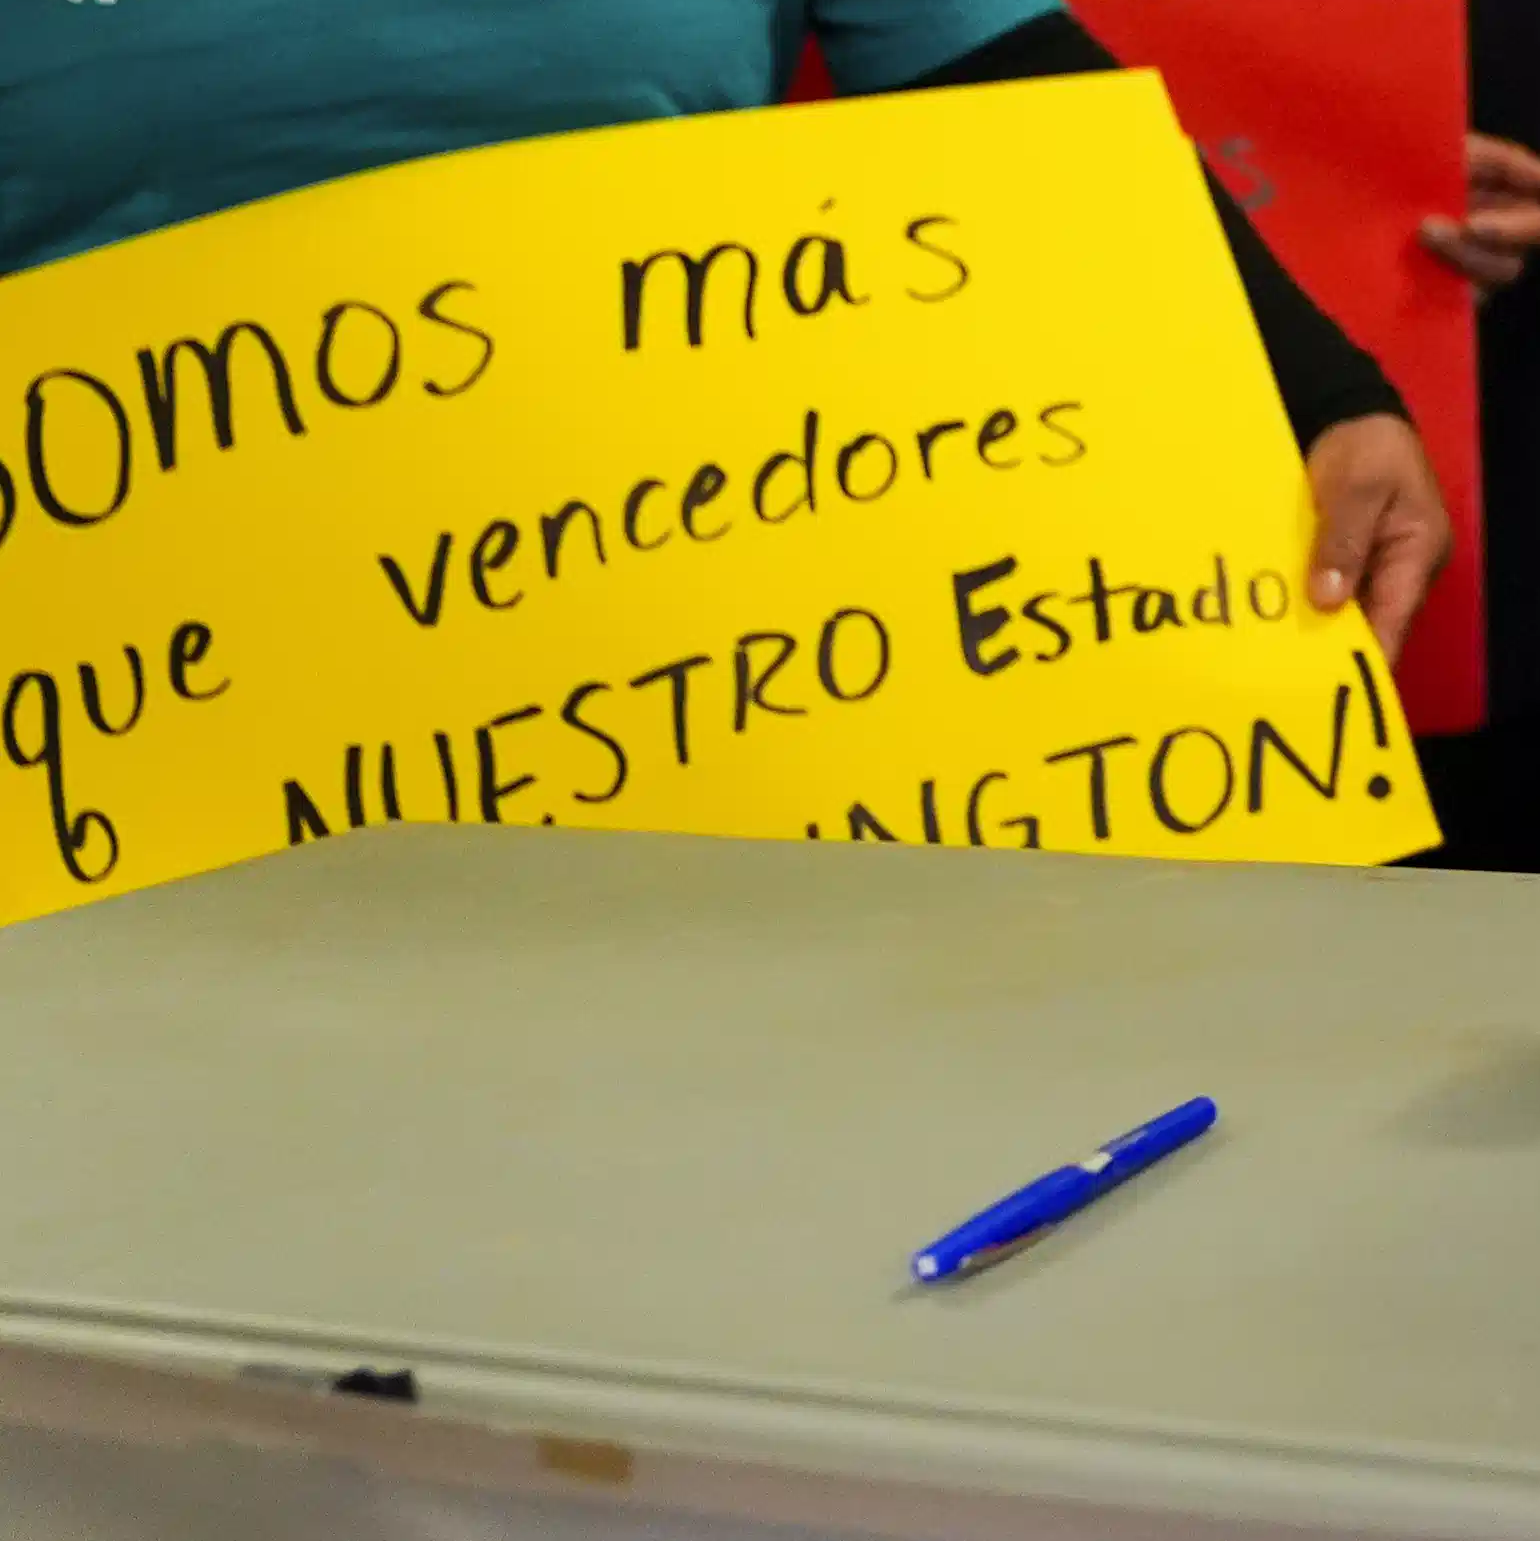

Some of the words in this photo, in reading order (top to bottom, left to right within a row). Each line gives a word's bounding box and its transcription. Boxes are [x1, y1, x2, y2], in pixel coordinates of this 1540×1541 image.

[0, 278, 496, 546] omos
[620, 198, 972, 355] más
[2, 618, 230, 885] que
[378, 398, 1090, 628] vencedores
[283, 608, 892, 848] NUESTRO
[952, 552, 1292, 678] Estado
